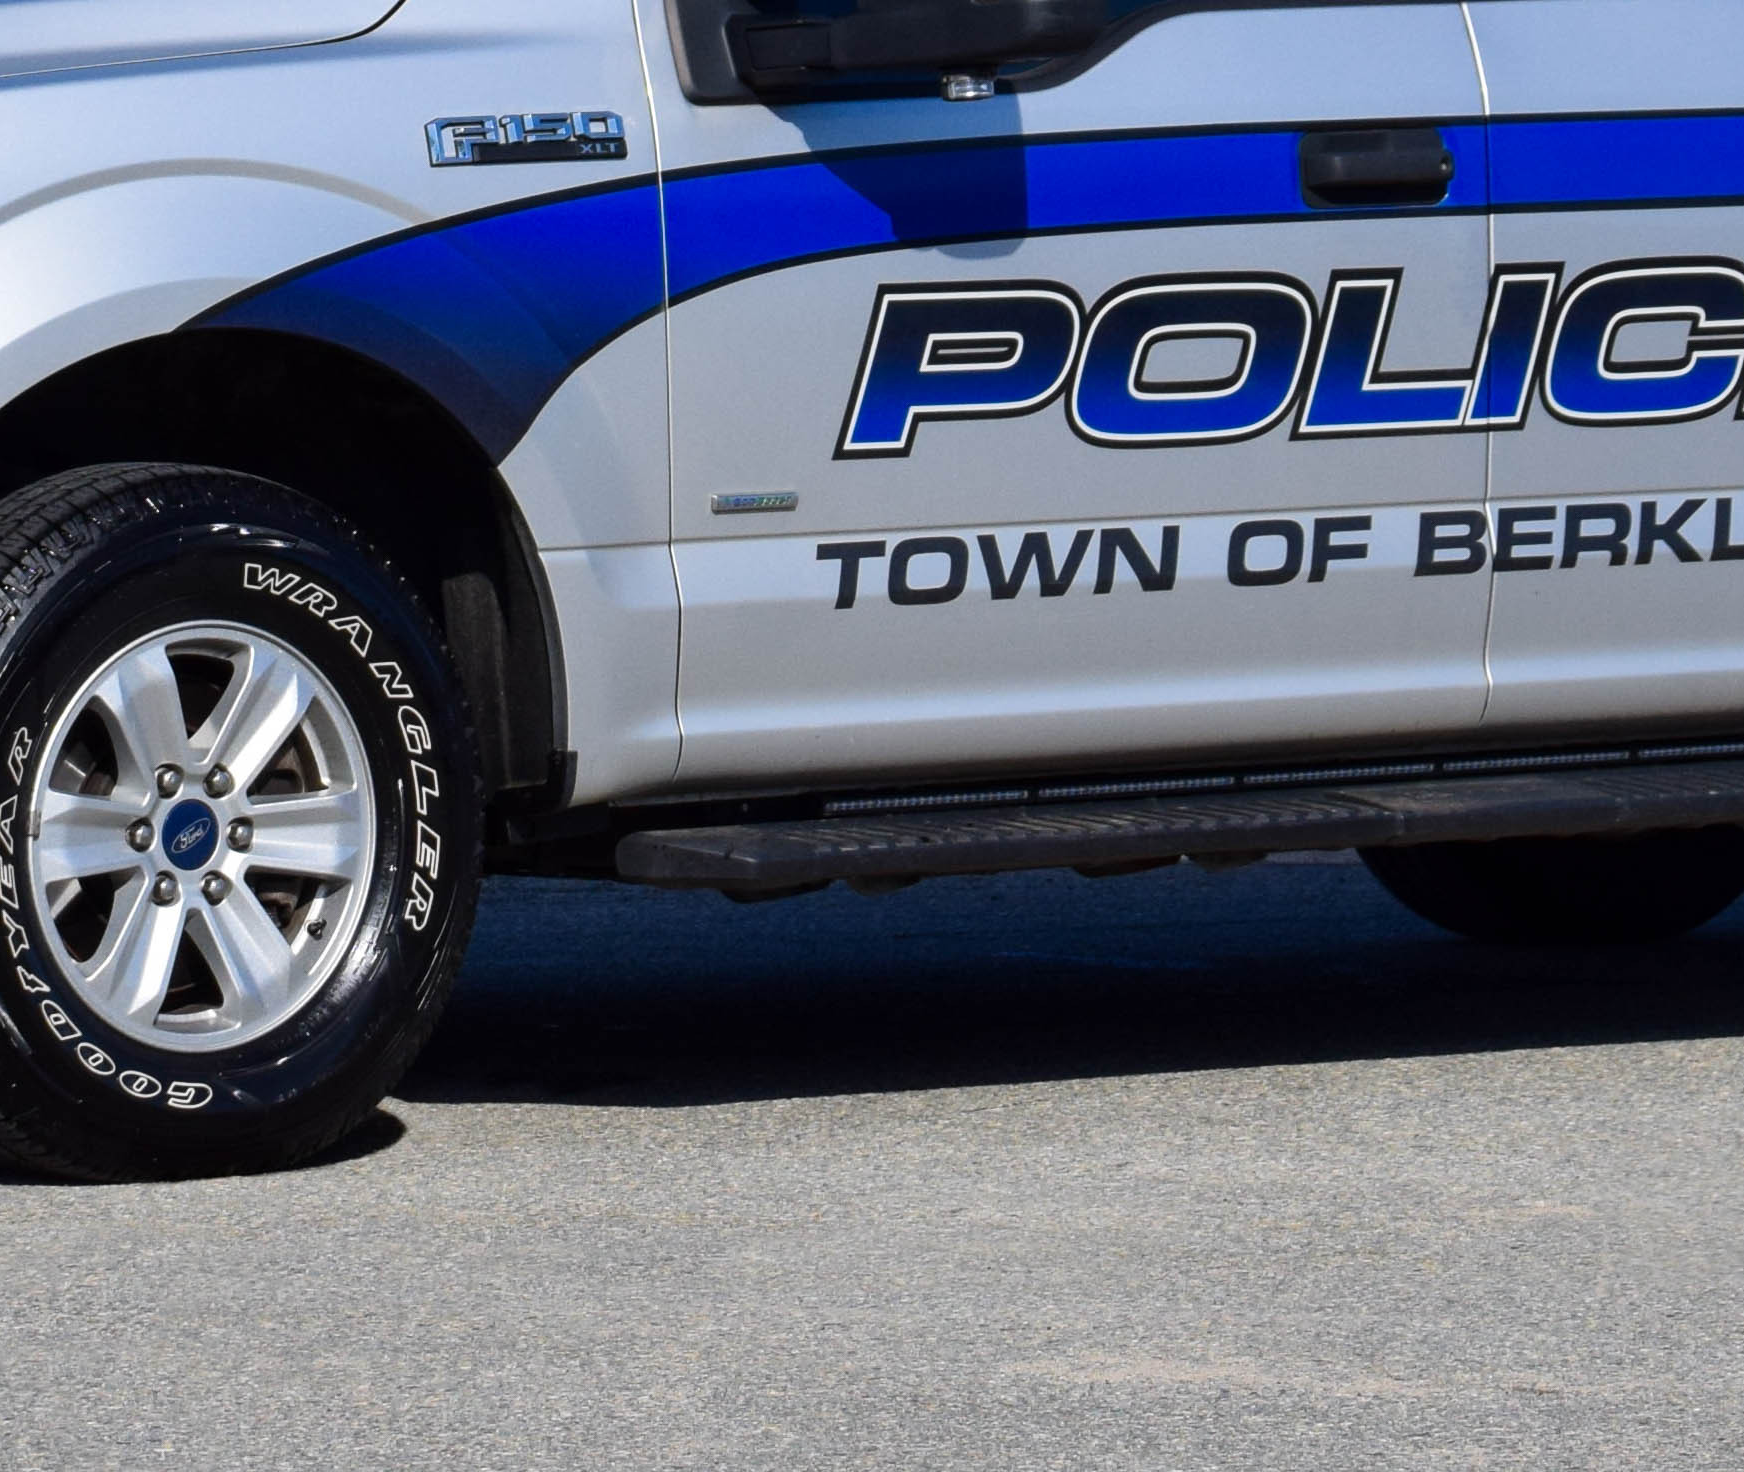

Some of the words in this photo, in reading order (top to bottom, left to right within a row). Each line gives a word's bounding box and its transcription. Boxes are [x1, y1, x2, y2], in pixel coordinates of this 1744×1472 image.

[579, 142, 620, 155] XLT
[816, 525, 1180, 610] TOWN
[1226, 514, 1373, 588] OF
[243, 562, 441, 932] WRANGLER
